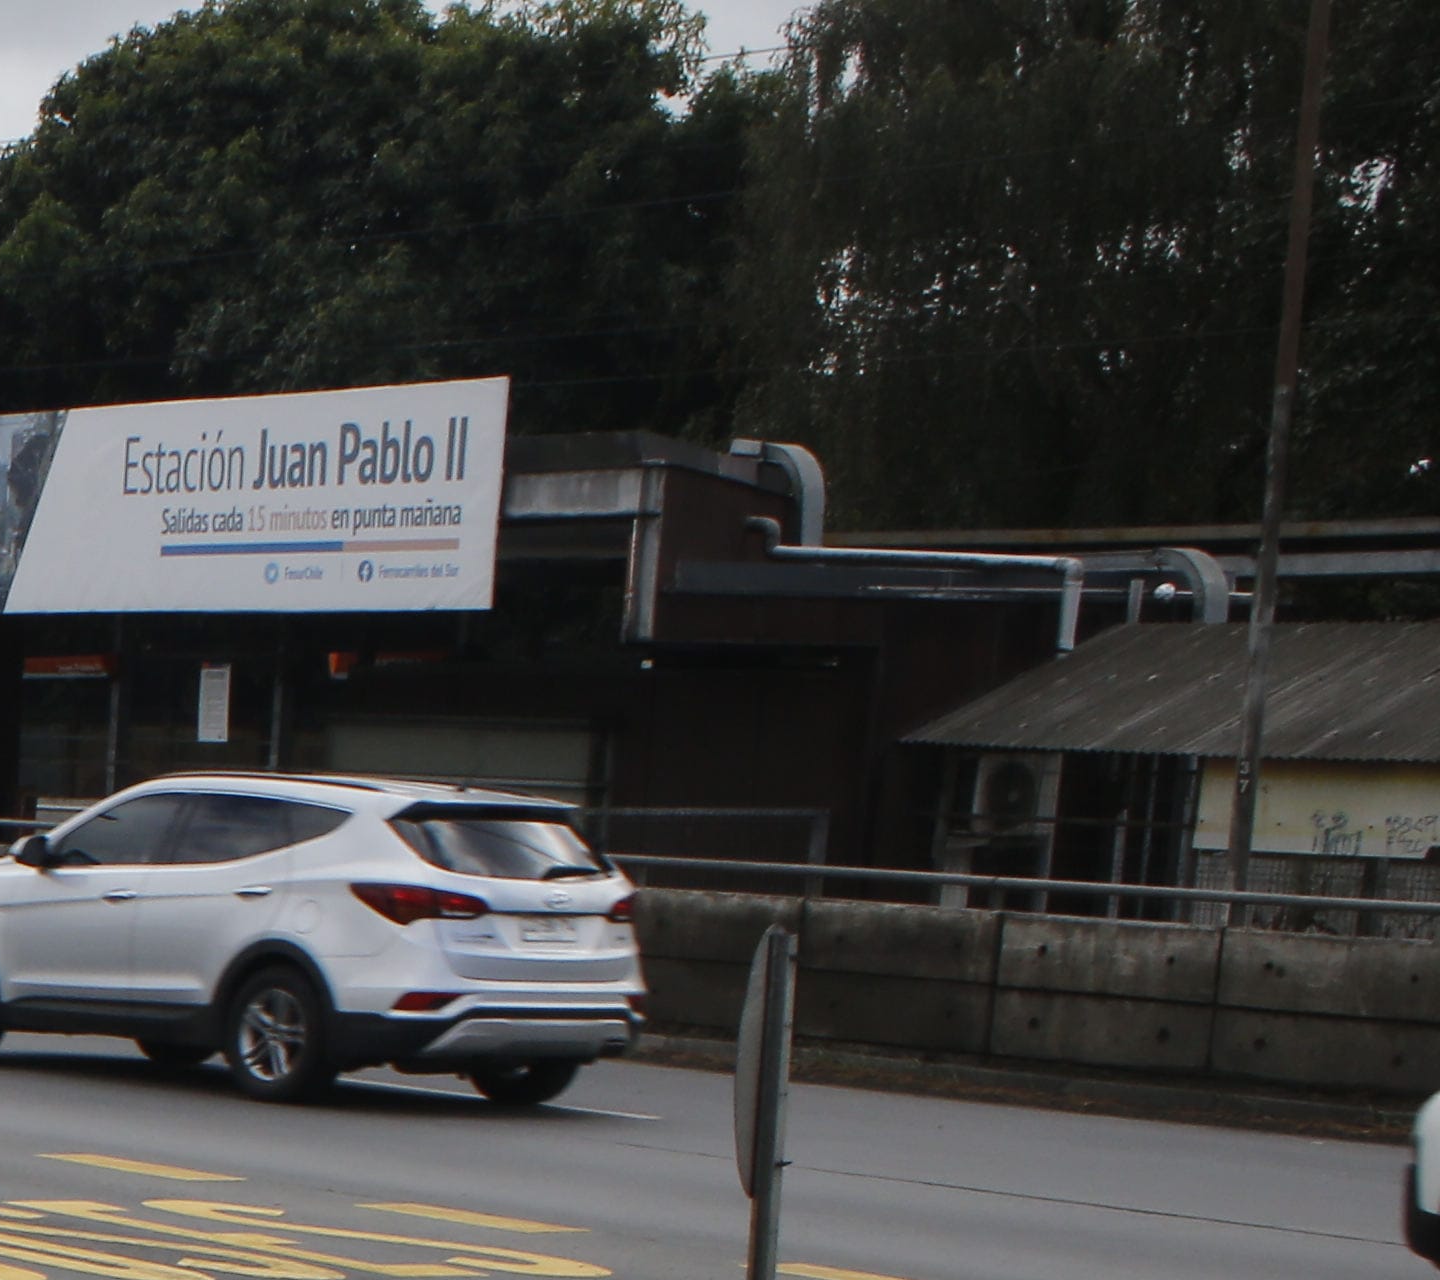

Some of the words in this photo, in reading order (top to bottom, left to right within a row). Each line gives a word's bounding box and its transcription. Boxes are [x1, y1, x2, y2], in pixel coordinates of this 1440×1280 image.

[123, 430, 244, 496] Estación
[253, 428, 328, 491] Juan
[337, 420, 435, 486] Pablo
[445, 416, 470, 481] II
[160, 507, 209, 535] Salidas
[212, 510, 243, 533] cada
[247, 507, 265, 532] 15
[269, 504, 328, 531] minutos
[331, 508, 350, 529] en
[353, 503, 396, 535] punta
[400, 499, 461, 528] mañana
[431, 563, 444, 578] del
